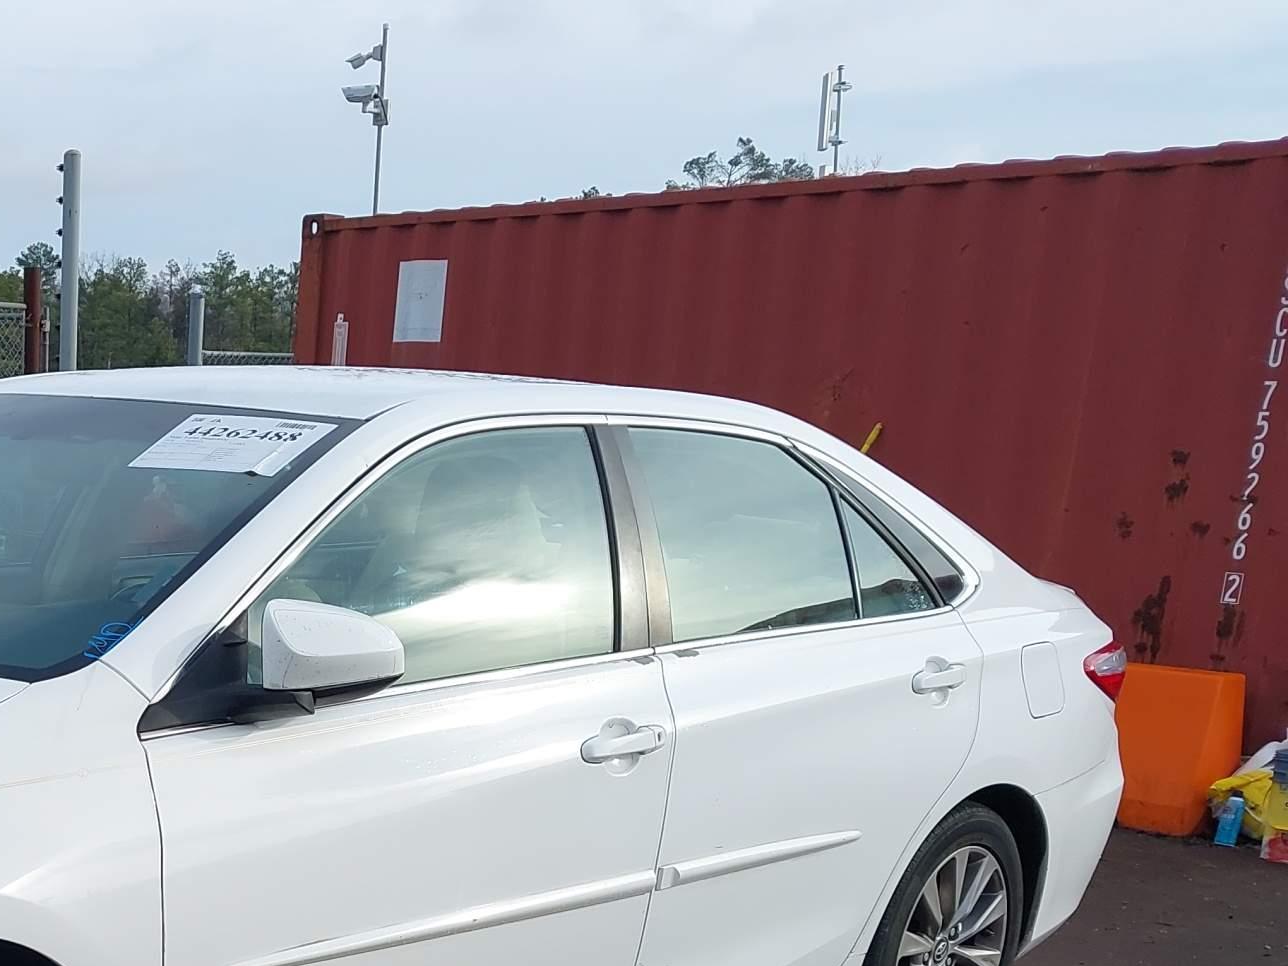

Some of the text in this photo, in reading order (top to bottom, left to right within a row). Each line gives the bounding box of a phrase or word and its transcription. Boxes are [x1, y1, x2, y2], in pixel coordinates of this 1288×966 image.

[183, 425, 303, 442] 44262488
[1232, 380, 1278, 560] 759266
[1222, 574, 1242, 602] 2
